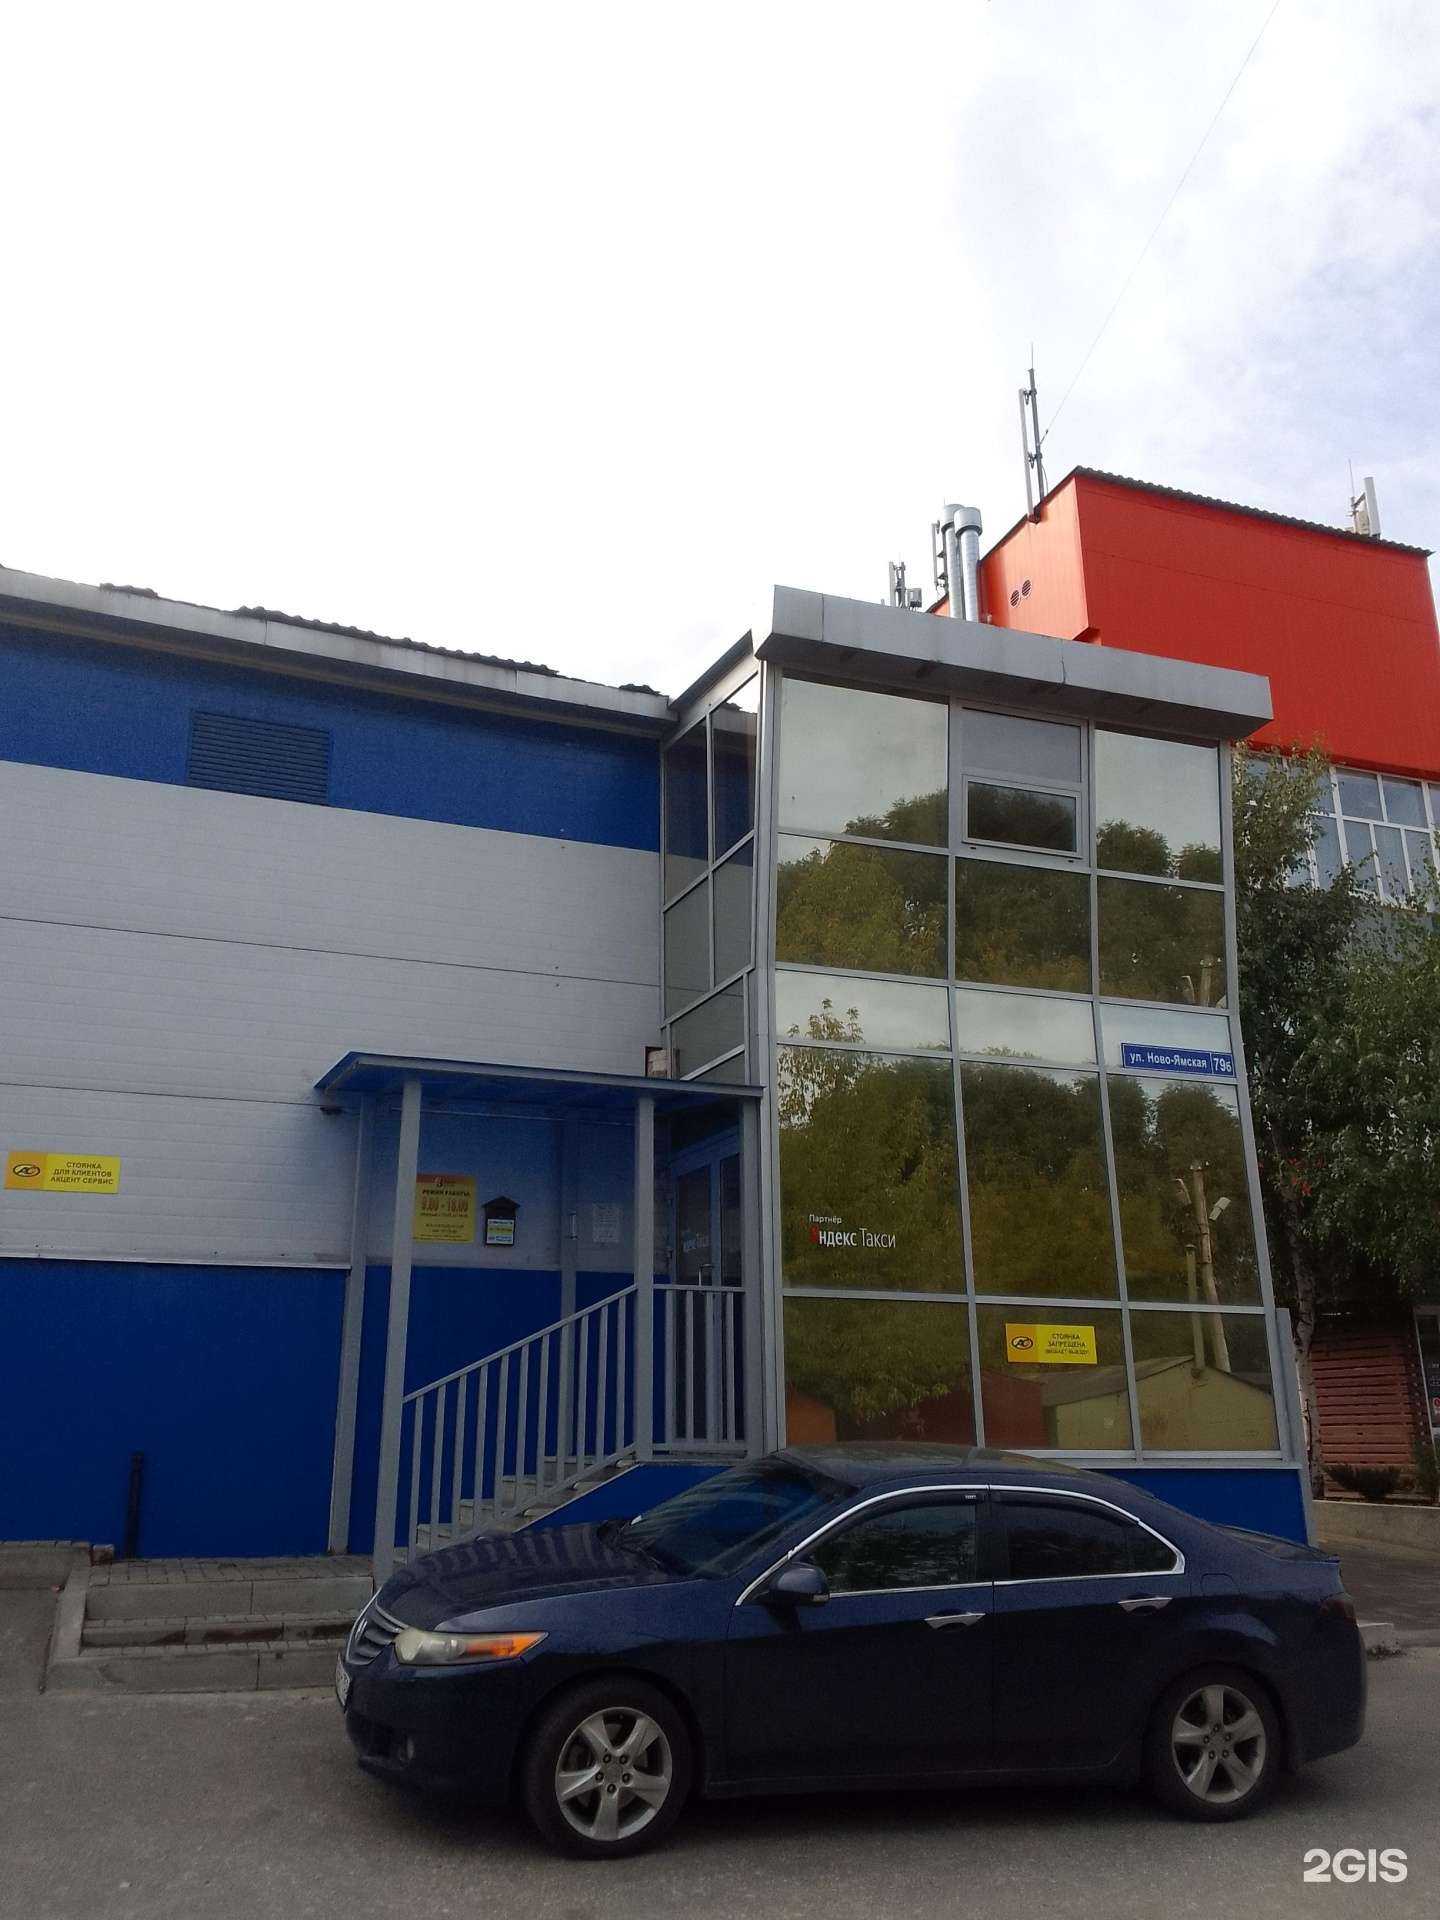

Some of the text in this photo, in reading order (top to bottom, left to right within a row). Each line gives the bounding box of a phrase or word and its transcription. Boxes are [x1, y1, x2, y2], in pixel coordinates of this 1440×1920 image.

[1129, 1053, 1145, 1064] ул.
[1147, 1051, 1208, 1069] Ново-Ямская
[65, 1161, 102, 1170] СТОЯНКА
[53, 1168, 112, 1178] ДЛЯ КЛИЕНТОВ
[50, 1176, 80, 1184] АКЦЕНТ
[809, 1213, 842, 1224] Партнёр
[810, 1226, 896, 1248] Яндекс Такси
